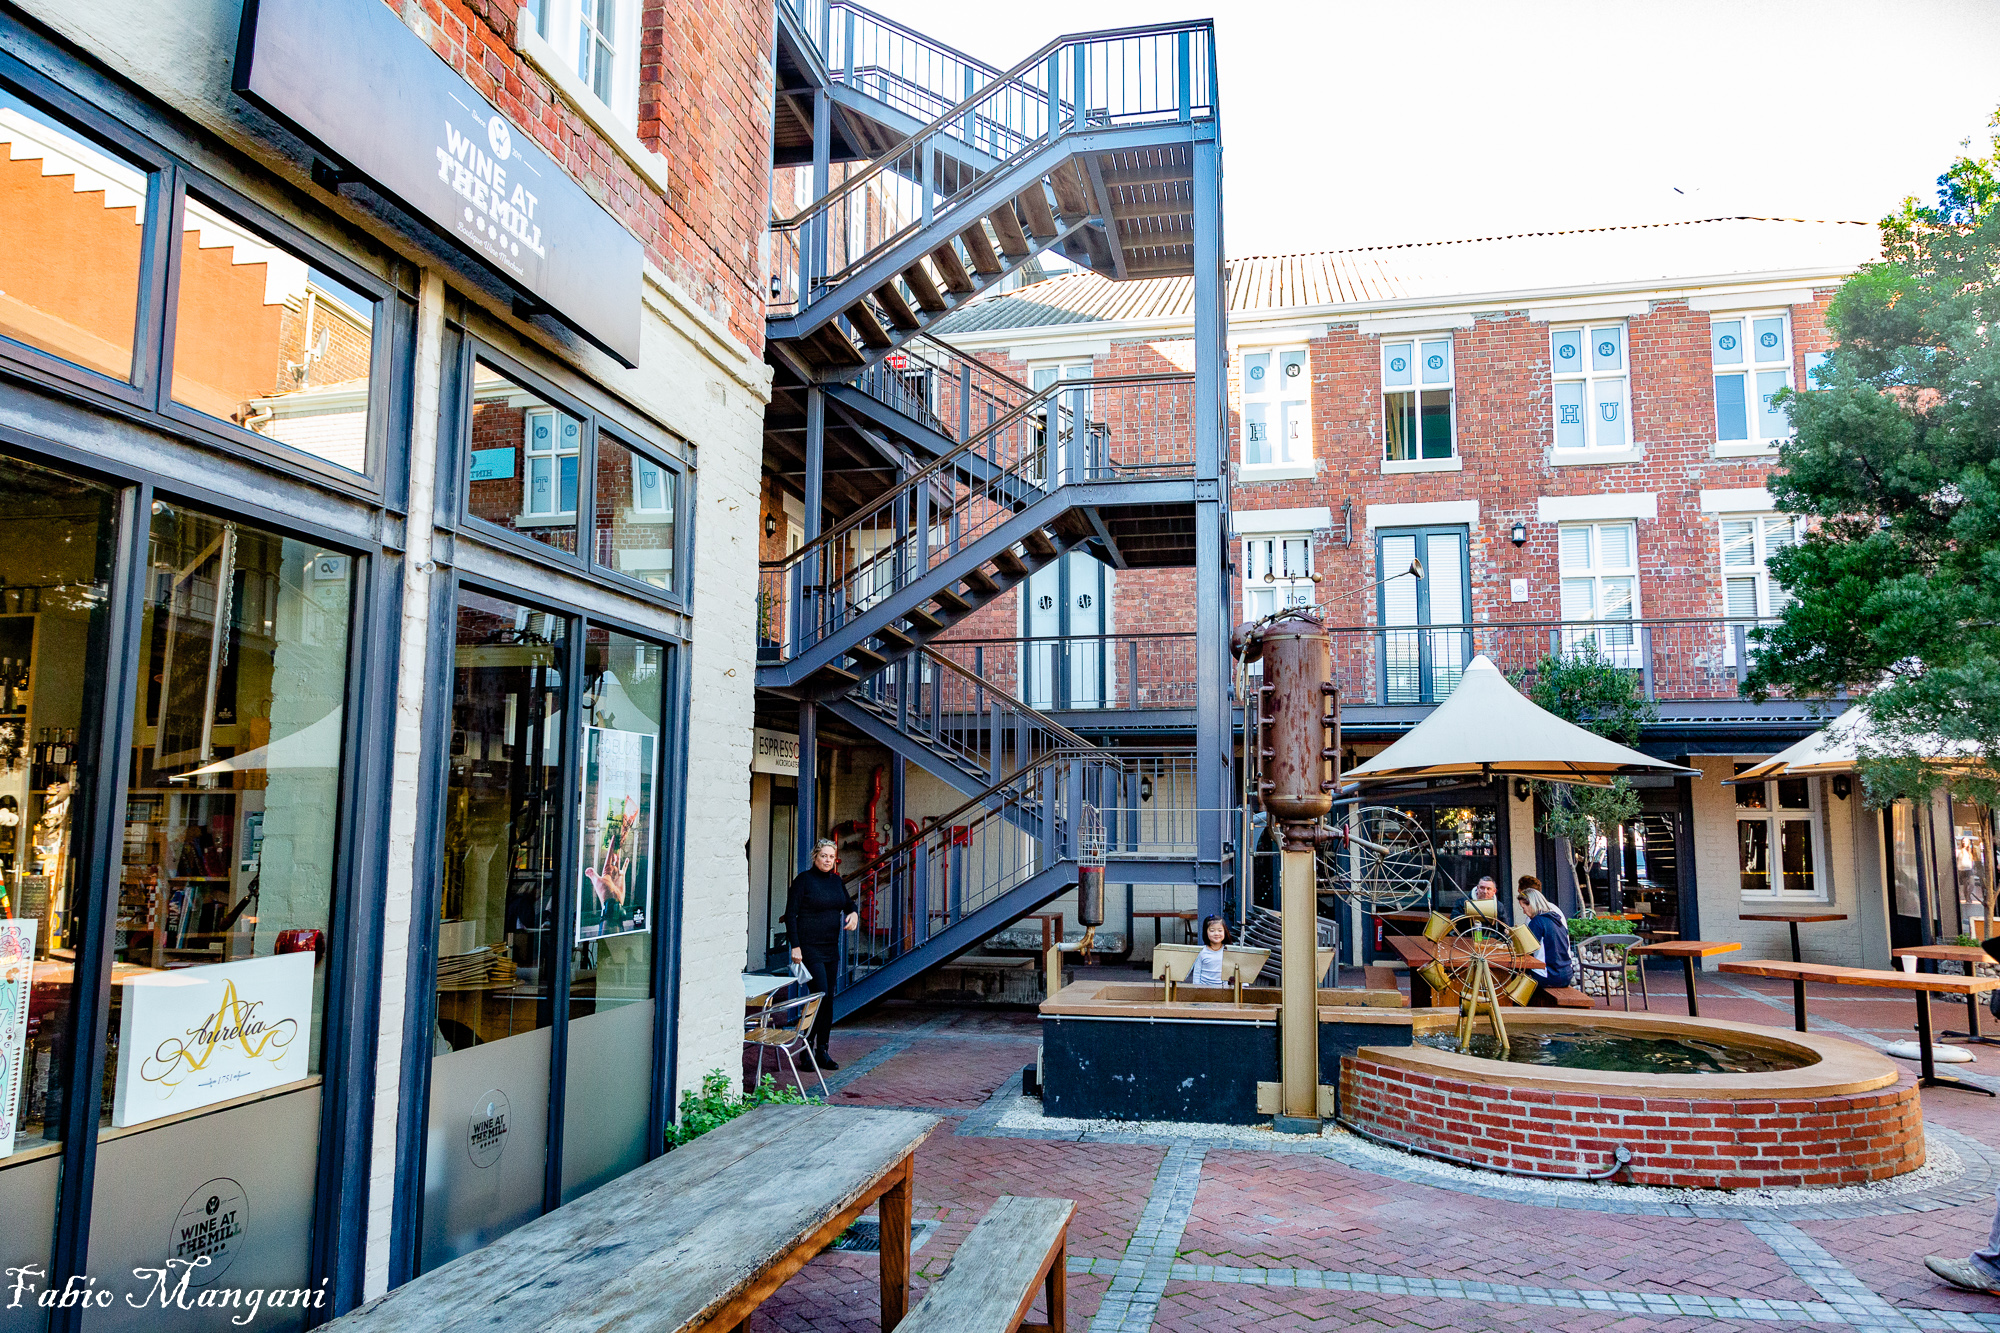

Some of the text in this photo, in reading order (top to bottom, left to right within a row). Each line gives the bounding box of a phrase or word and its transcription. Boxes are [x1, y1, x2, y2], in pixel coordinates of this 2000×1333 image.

[445, 119, 538, 220] WINE AT
[457, 221, 524, 277] Boutique Wine Merchant
[168, 902, 181, 932] WINE
[474, 1114, 505, 1133] WINE AT
[181, 1210, 236, 1241] WINE AT
